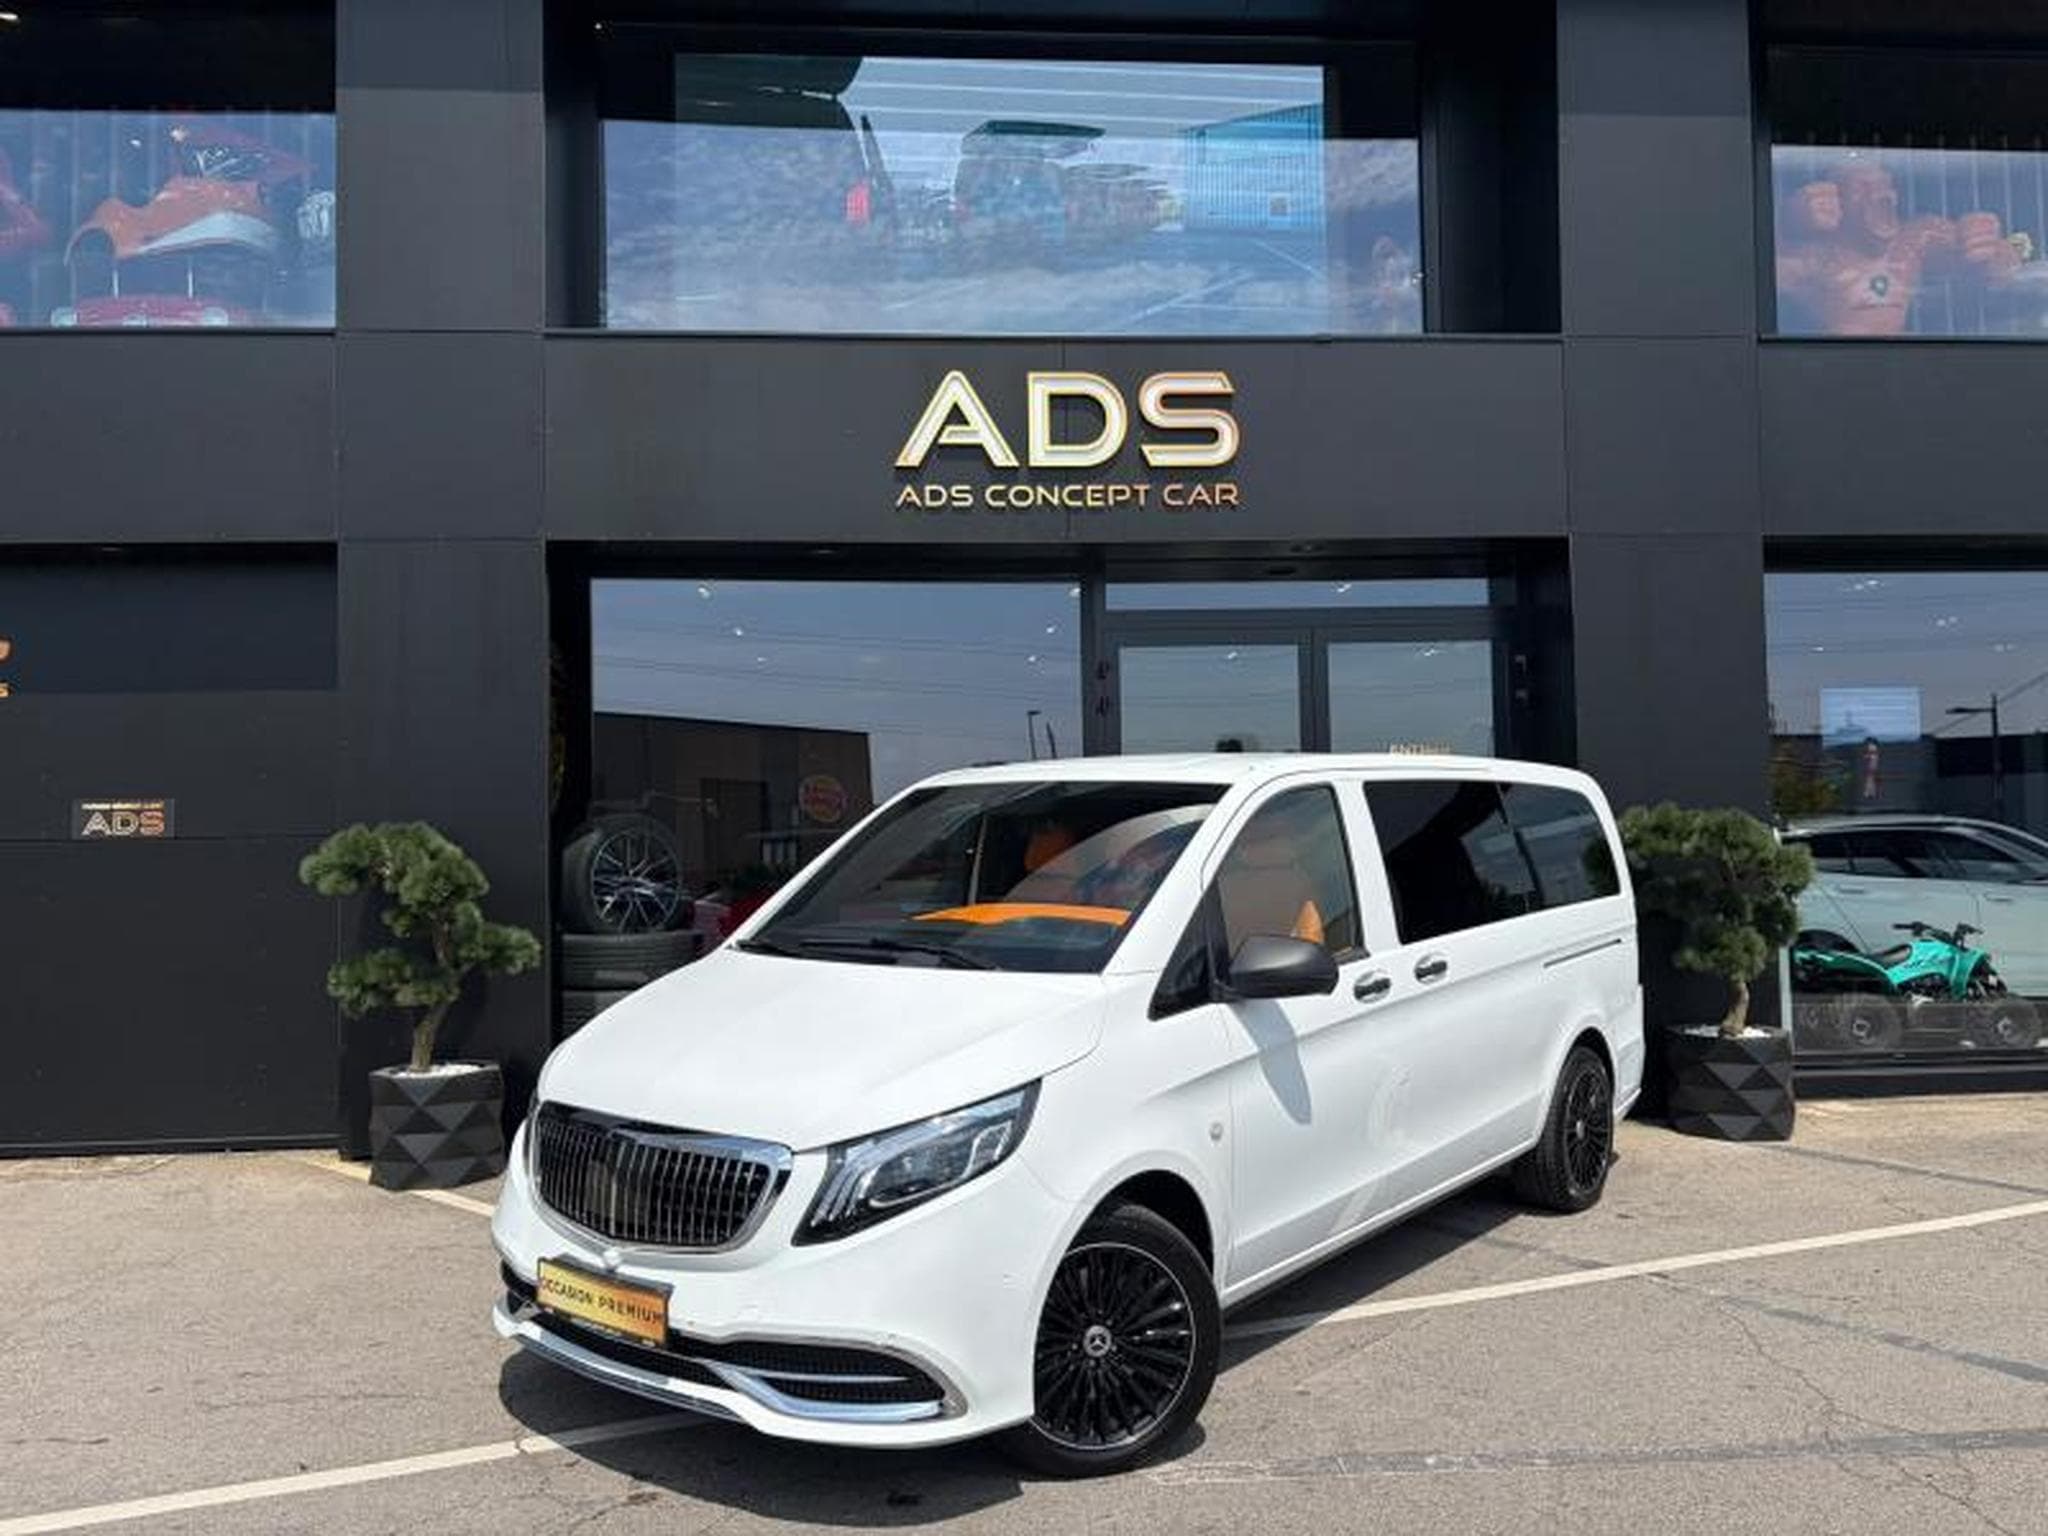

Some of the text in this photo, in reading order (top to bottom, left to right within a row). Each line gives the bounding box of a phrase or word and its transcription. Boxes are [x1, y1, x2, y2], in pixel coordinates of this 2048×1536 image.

[895, 370, 1240, 468] ADS
[896, 483, 1240, 507] ADS CONCEPT CAR
[82, 811, 165, 836] ADS
[538, 1277, 663, 1325] OCCASION PREMIUM
